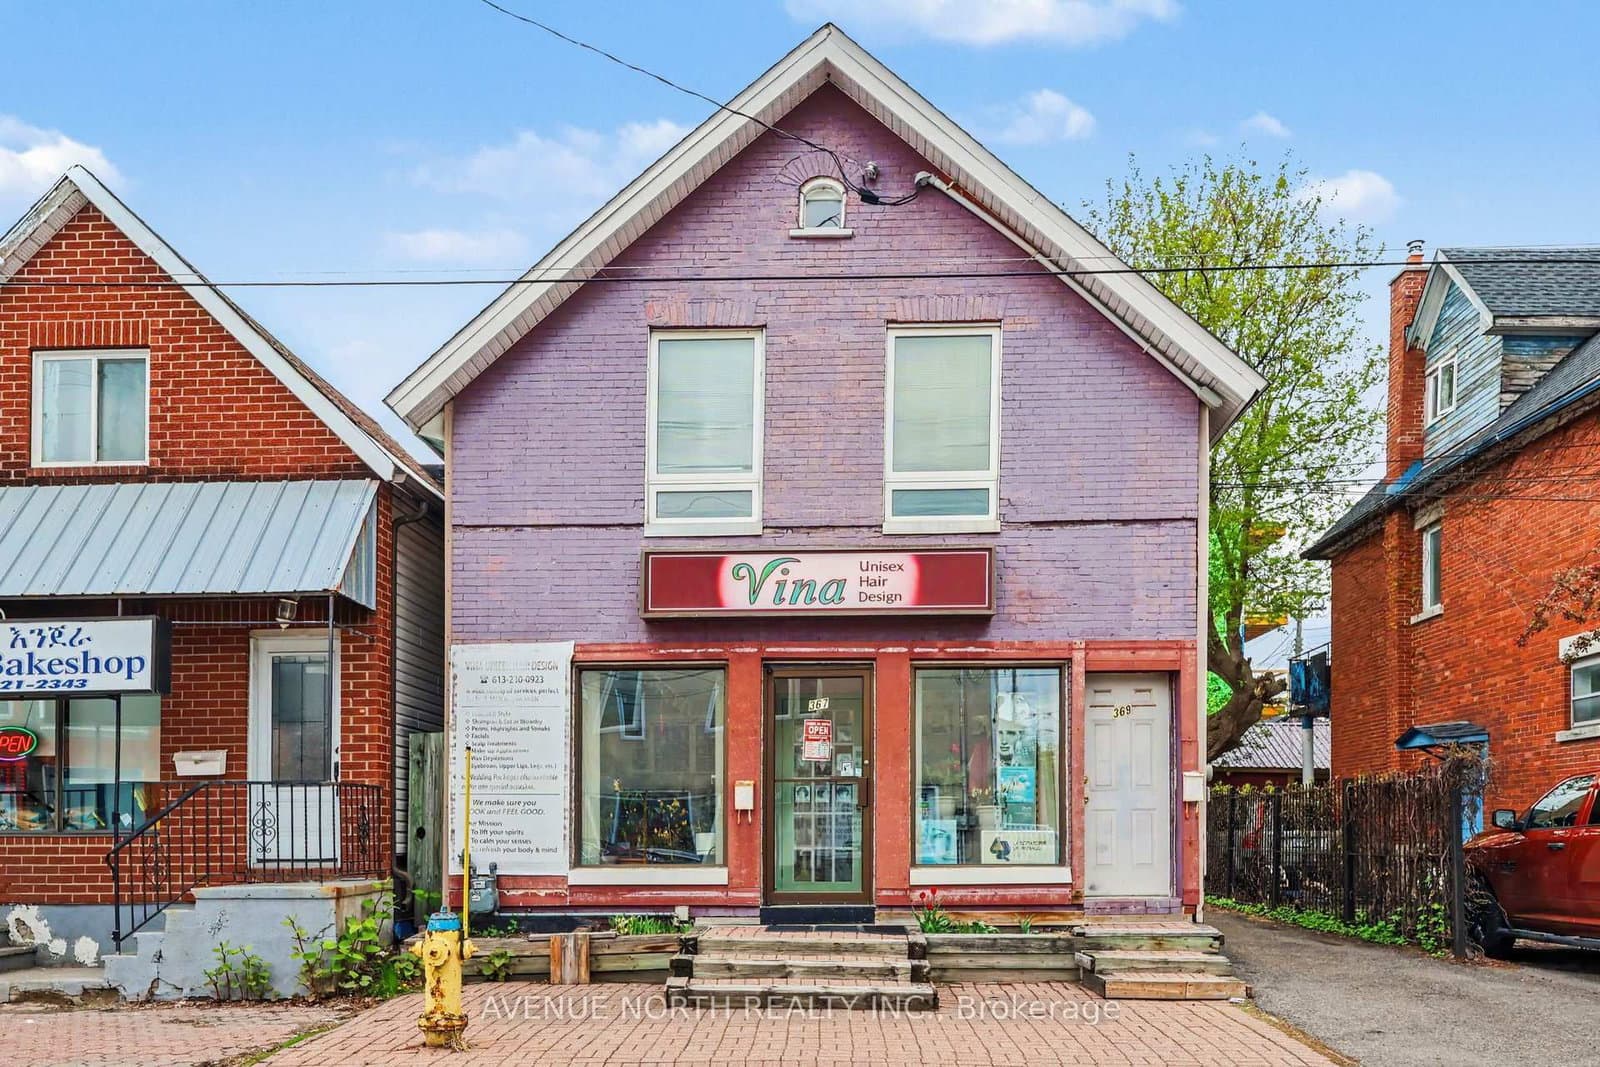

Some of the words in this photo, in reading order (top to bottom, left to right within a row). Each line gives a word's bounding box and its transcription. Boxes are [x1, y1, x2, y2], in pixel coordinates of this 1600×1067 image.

[859, 560, 905, 573] Unisex
[732, 557, 847, 606] Vina
[859, 576, 888, 588] Hair
[858, 591, 903, 603] Design
[0, 650, 146, 680] akeshop
[1113, 704, 1132, 718] 369
[808, 726, 829, 735] OPEN
[0, 735, 32, 752] PEN
[522, 800, 537, 808] you
[505, 829, 525, 837] spirits
[518, 847, 534, 855] body
